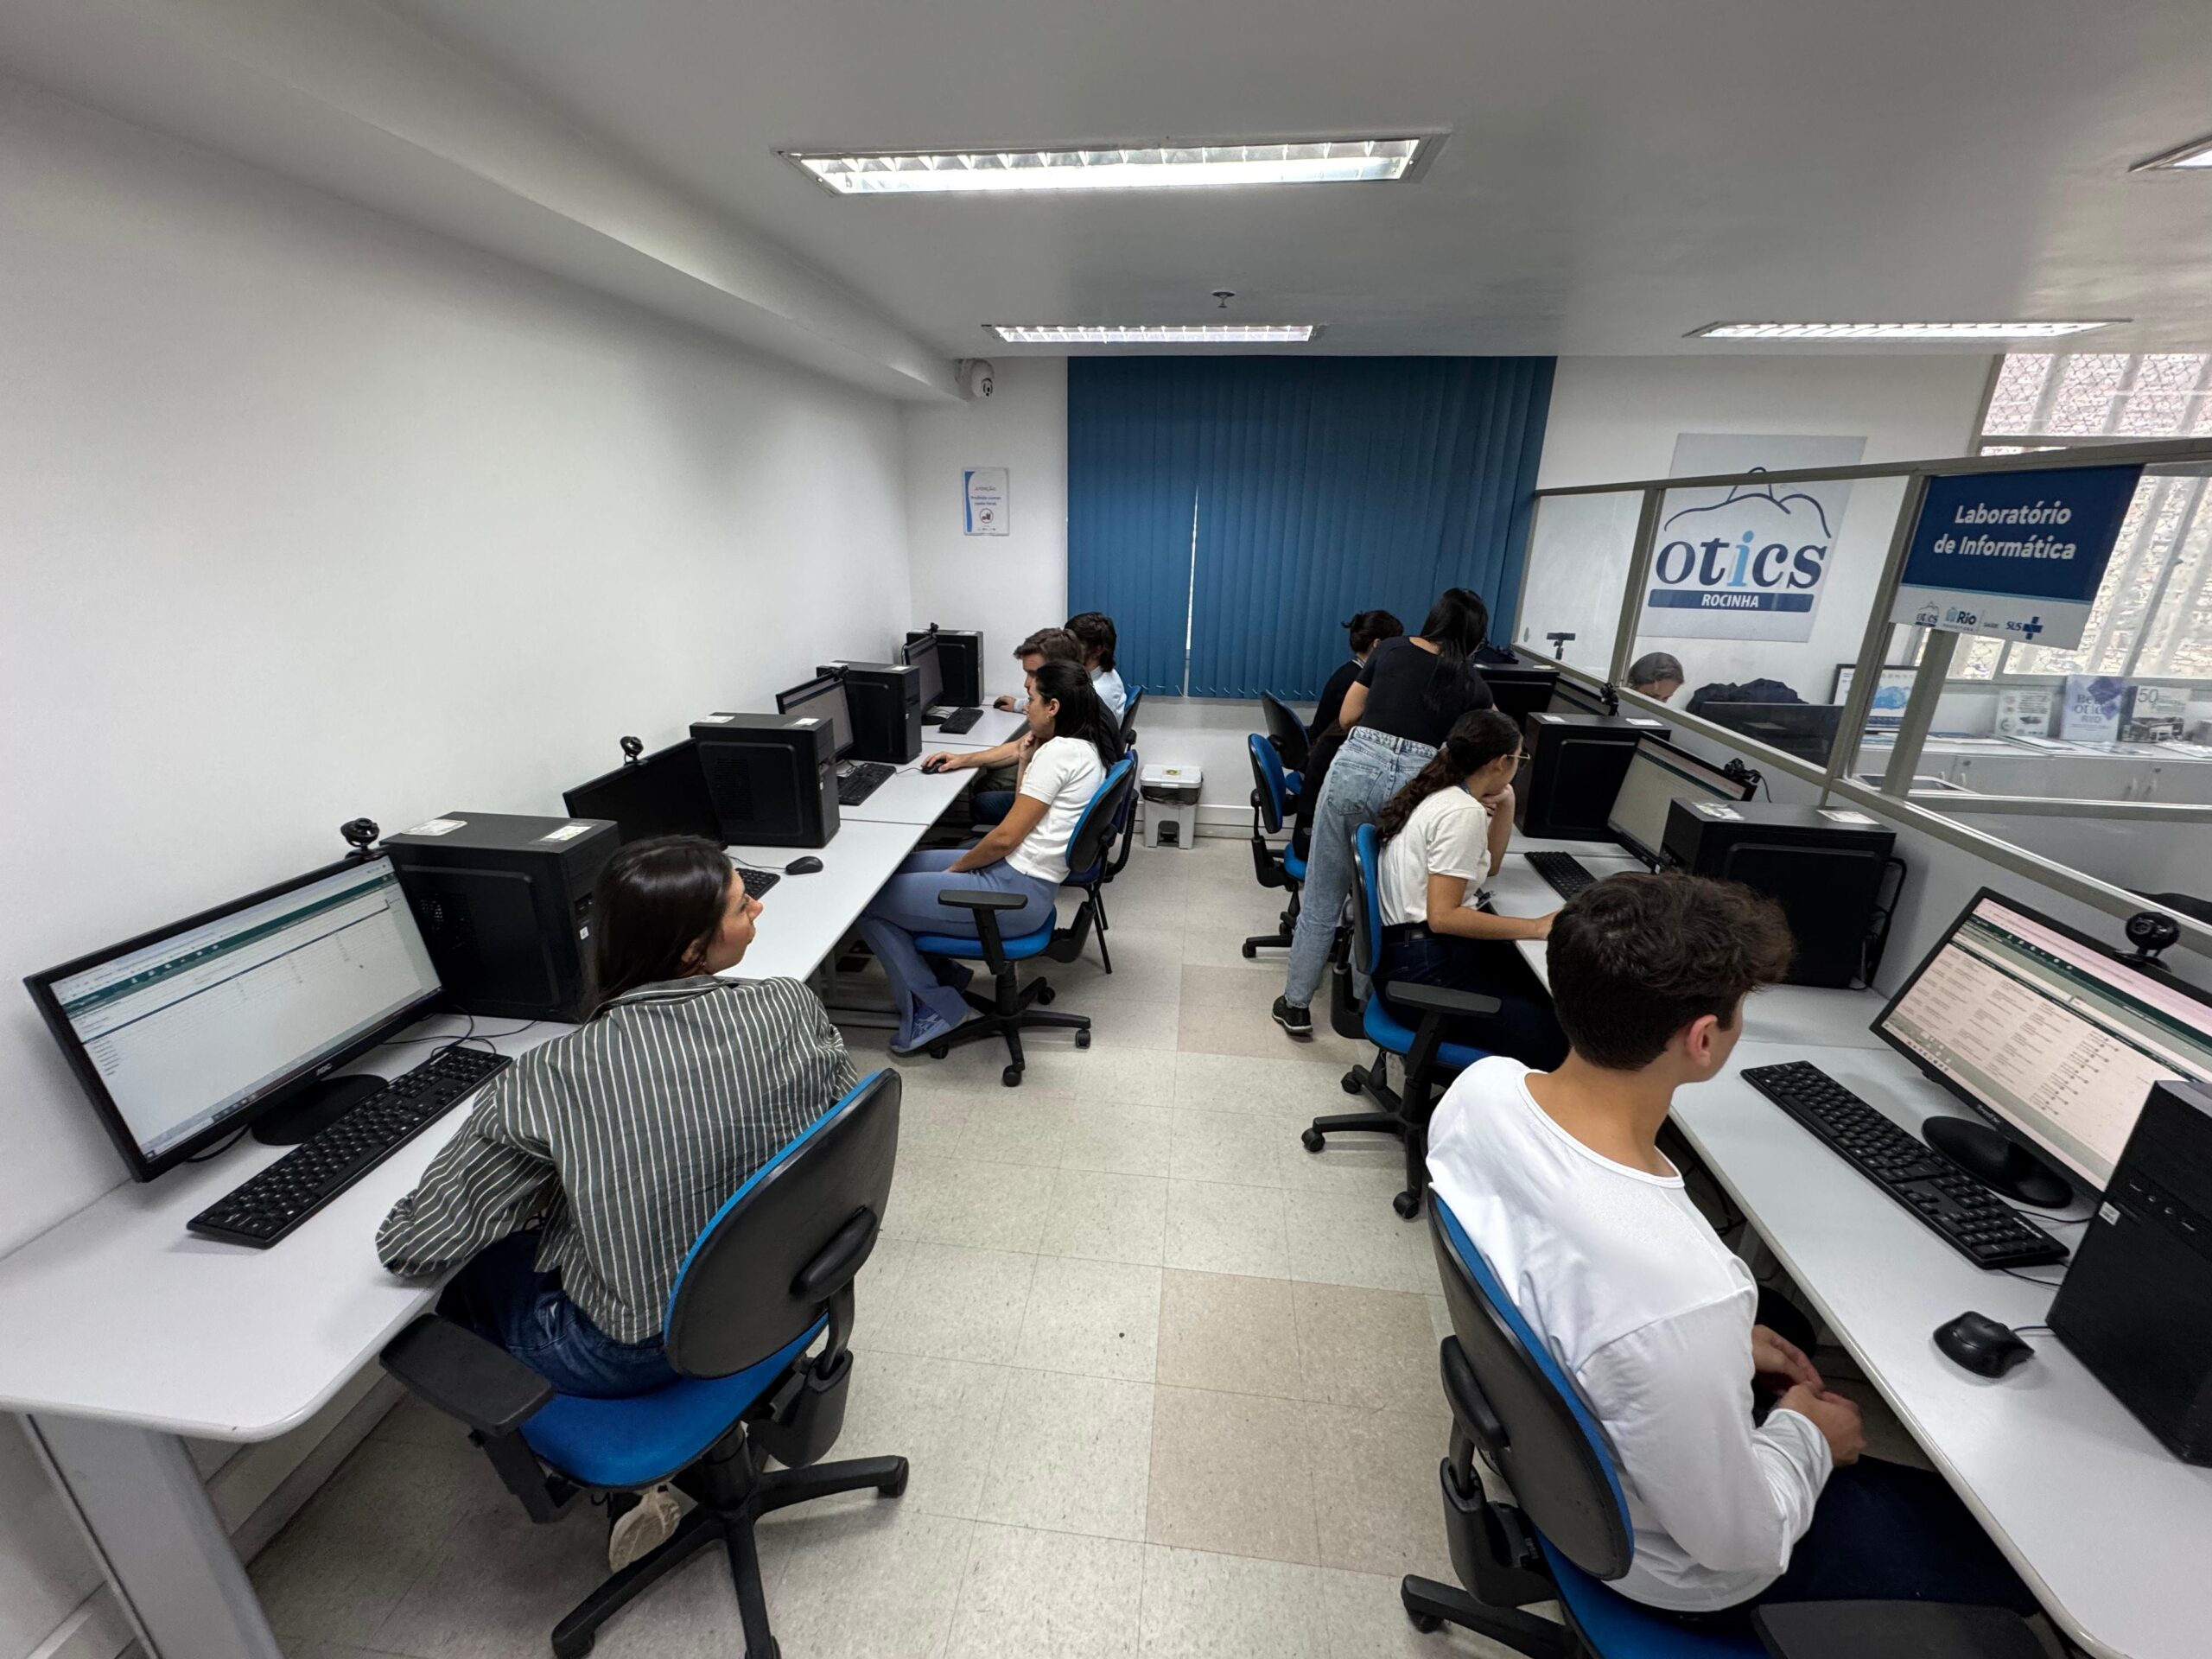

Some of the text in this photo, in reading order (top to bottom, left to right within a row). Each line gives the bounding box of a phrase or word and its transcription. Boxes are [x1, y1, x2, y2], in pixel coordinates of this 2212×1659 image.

[1955, 500, 2071, 524] Laboratório
[1934, 533, 2076, 560] de Informática
[1701, 594, 1759, 608] ROCINHA
[1956, 611, 1977, 626] Rio
[2005, 620, 2023, 632] SUS
[2138, 688, 2158, 703] 50
